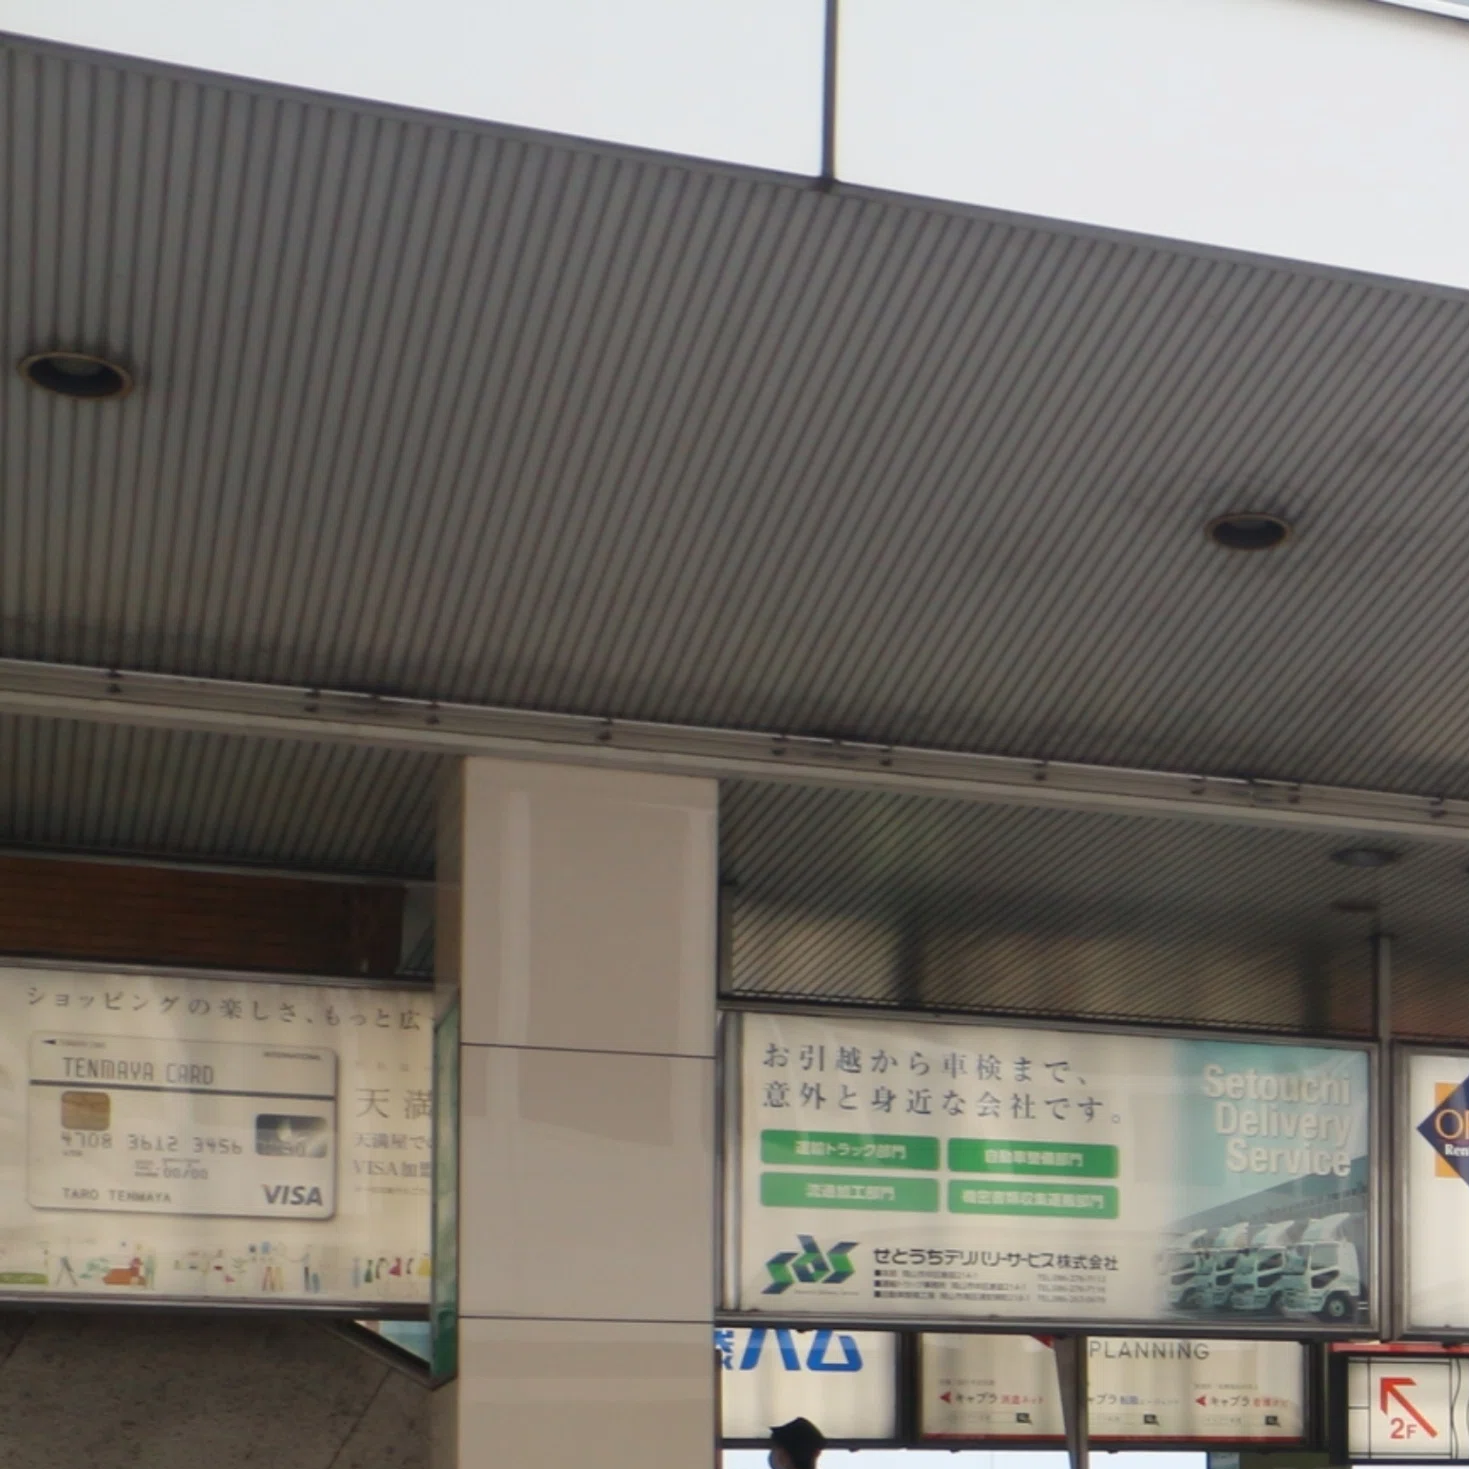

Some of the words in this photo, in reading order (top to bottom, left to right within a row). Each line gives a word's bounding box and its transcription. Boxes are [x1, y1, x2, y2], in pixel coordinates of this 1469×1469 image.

[27, 986, 433, 1030] ショッピングの楽しさ、もっと広
[63, 1057, 154, 1081] TENMAYA
[166, 1063, 214, 1086] CARD
[763, 1043, 1088, 1086] お引越から車検まで、
[1202, 1064, 1352, 1107] Setouchi
[763, 1081, 1121, 1125] 意外と身近な会社です。
[1215, 1101, 1353, 1145] Delivery
[355, 1133, 433, 1150] 天満屋で
[1226, 1139, 1352, 1178] Service
[263, 1185, 323, 1206] VISA
[874, 1249, 1119, 1270] せとうちデリバリーサービス株式会社
[1089, 1341, 1211, 1360] PLANNING
[1390, 1418, 1417, 1440] 2F
